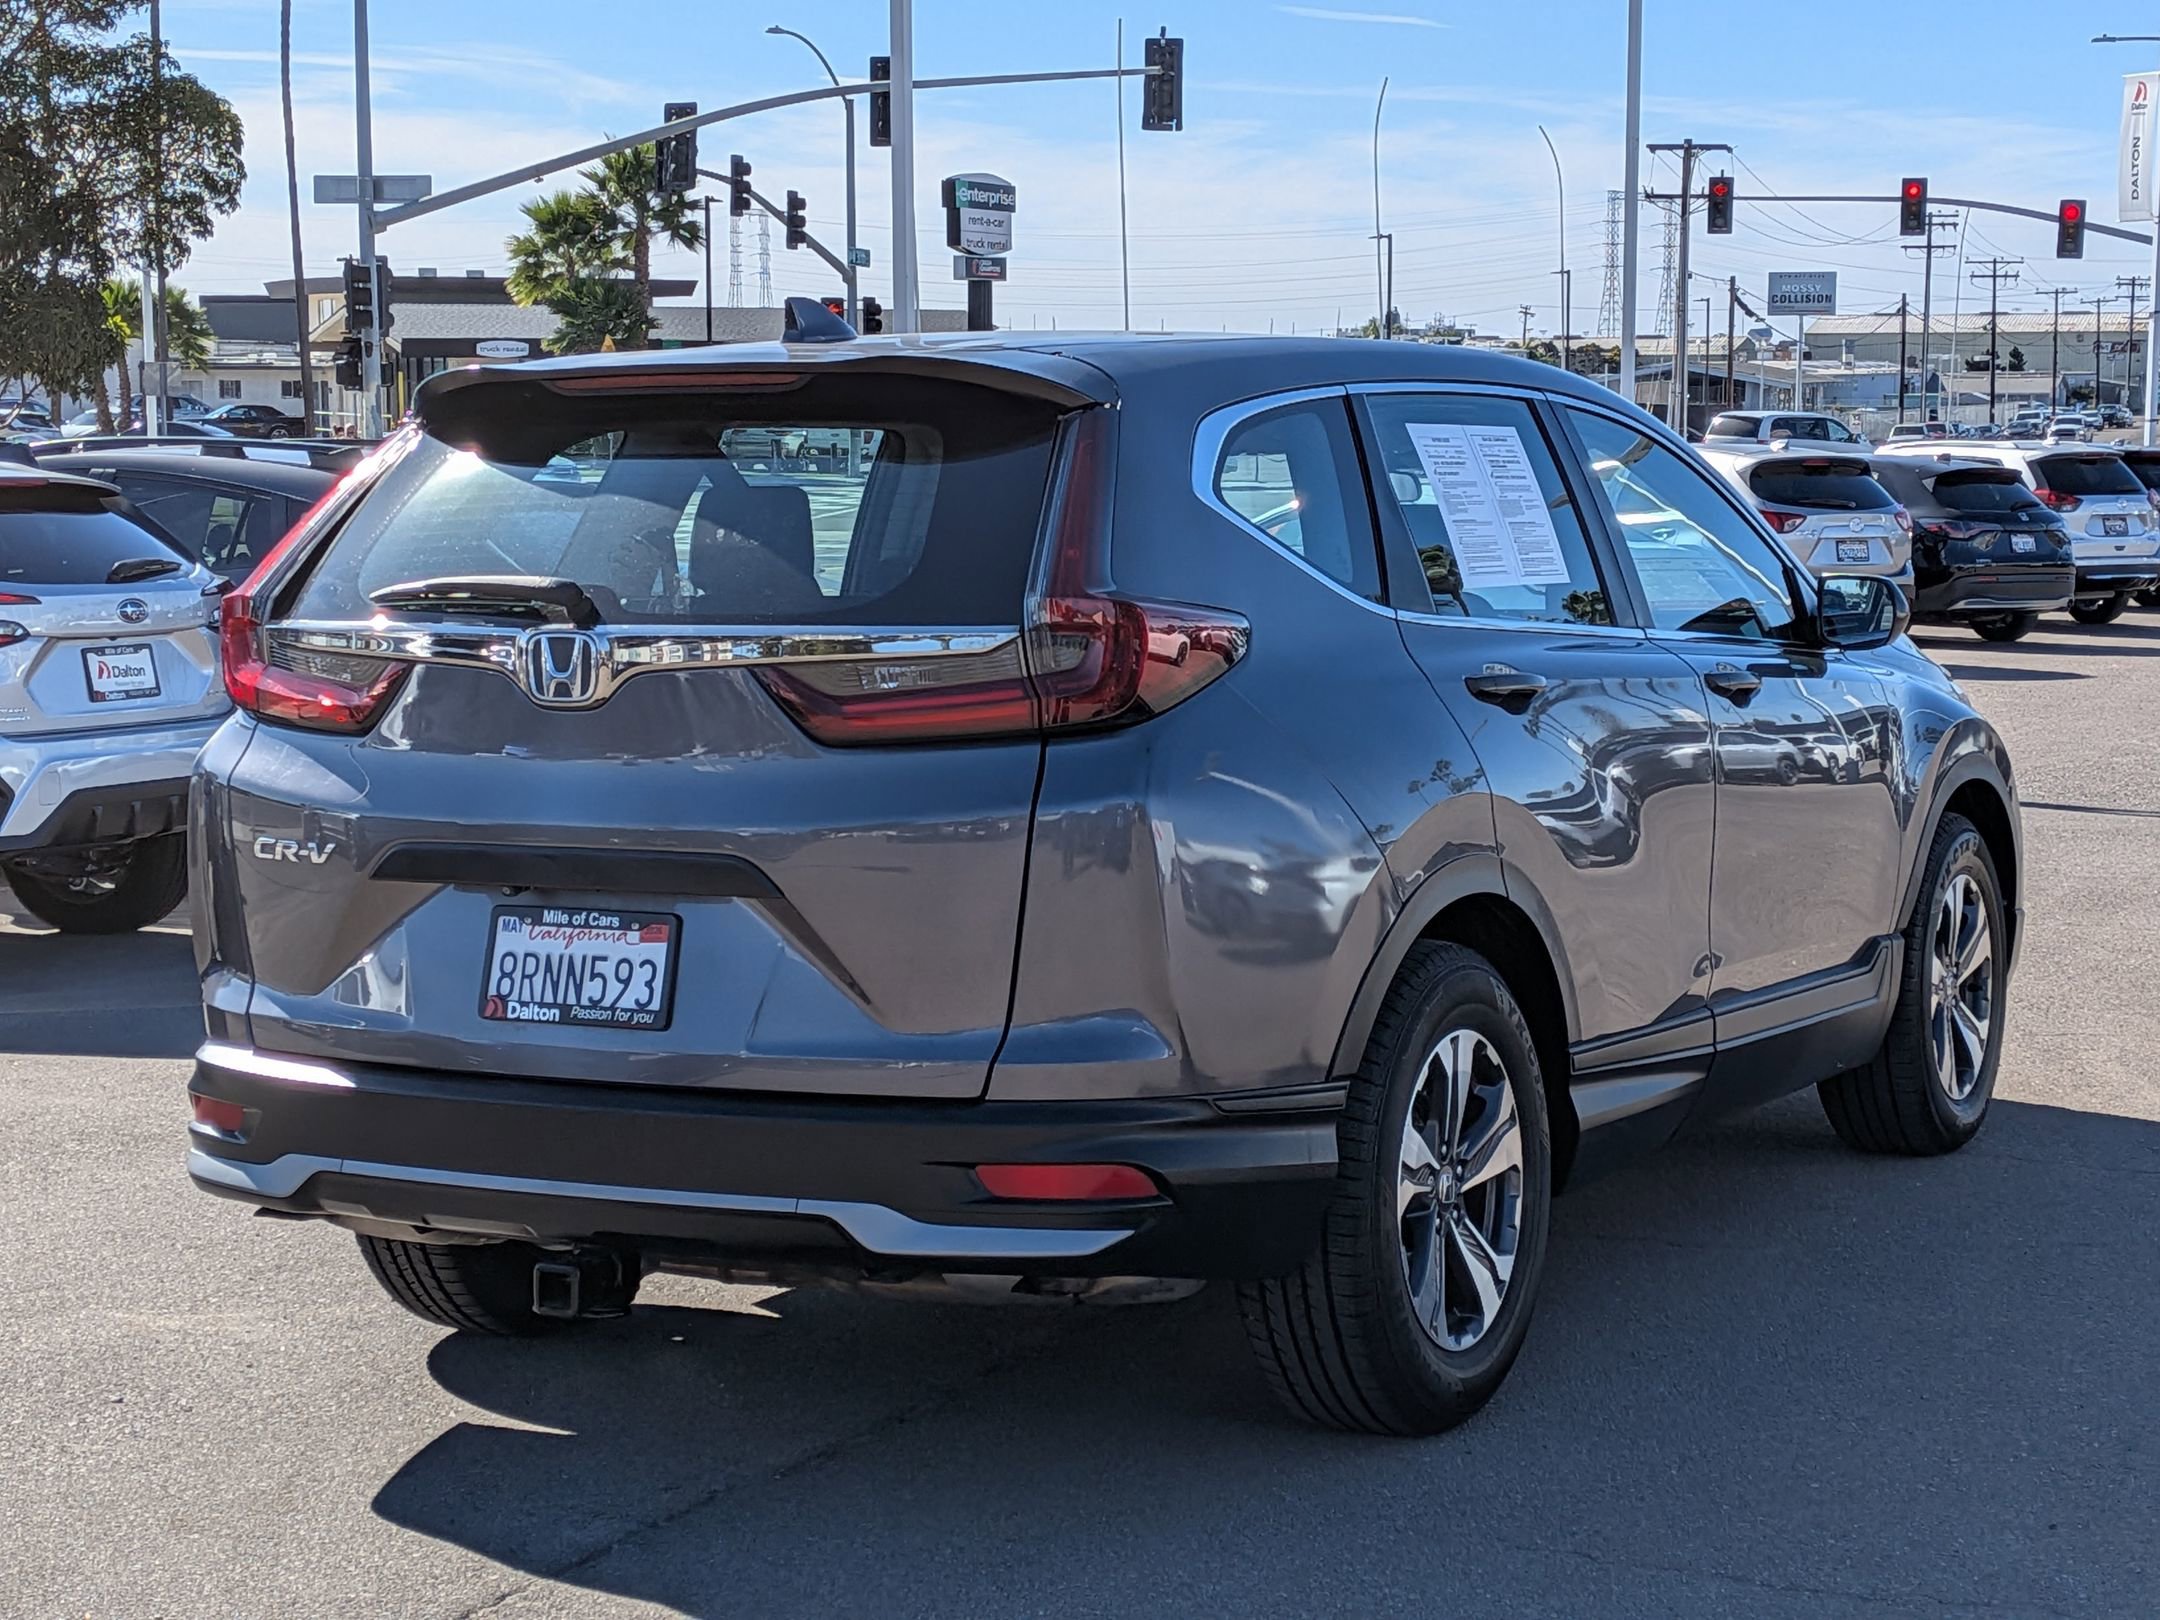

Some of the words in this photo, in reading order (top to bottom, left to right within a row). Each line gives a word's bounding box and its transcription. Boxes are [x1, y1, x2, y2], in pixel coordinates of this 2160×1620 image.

[2131, 136, 2141, 201] DALTON
[960, 187, 1015, 207] enterprise
[968, 216, 1006, 228] rent-a-car
[966, 238, 986, 249] truck
[1781, 284, 1821, 293] MOSSY
[1771, 294, 1832, 304] COLLISION
[112, 664, 146, 678] Dalton
[254, 837, 336, 864] CR-V
[542, 909, 569, 925] Mile
[572, 911, 587, 926] of
[589, 912, 620, 928] Cars
[528, 924, 640, 950] California
[496, 951, 657, 1010] 8RNN593
[507, 1002, 560, 1022] Dalton
[570, 1006, 612, 1021] Passion
[613, 1008, 630, 1022] for
[632, 1013, 655, 1025] you
